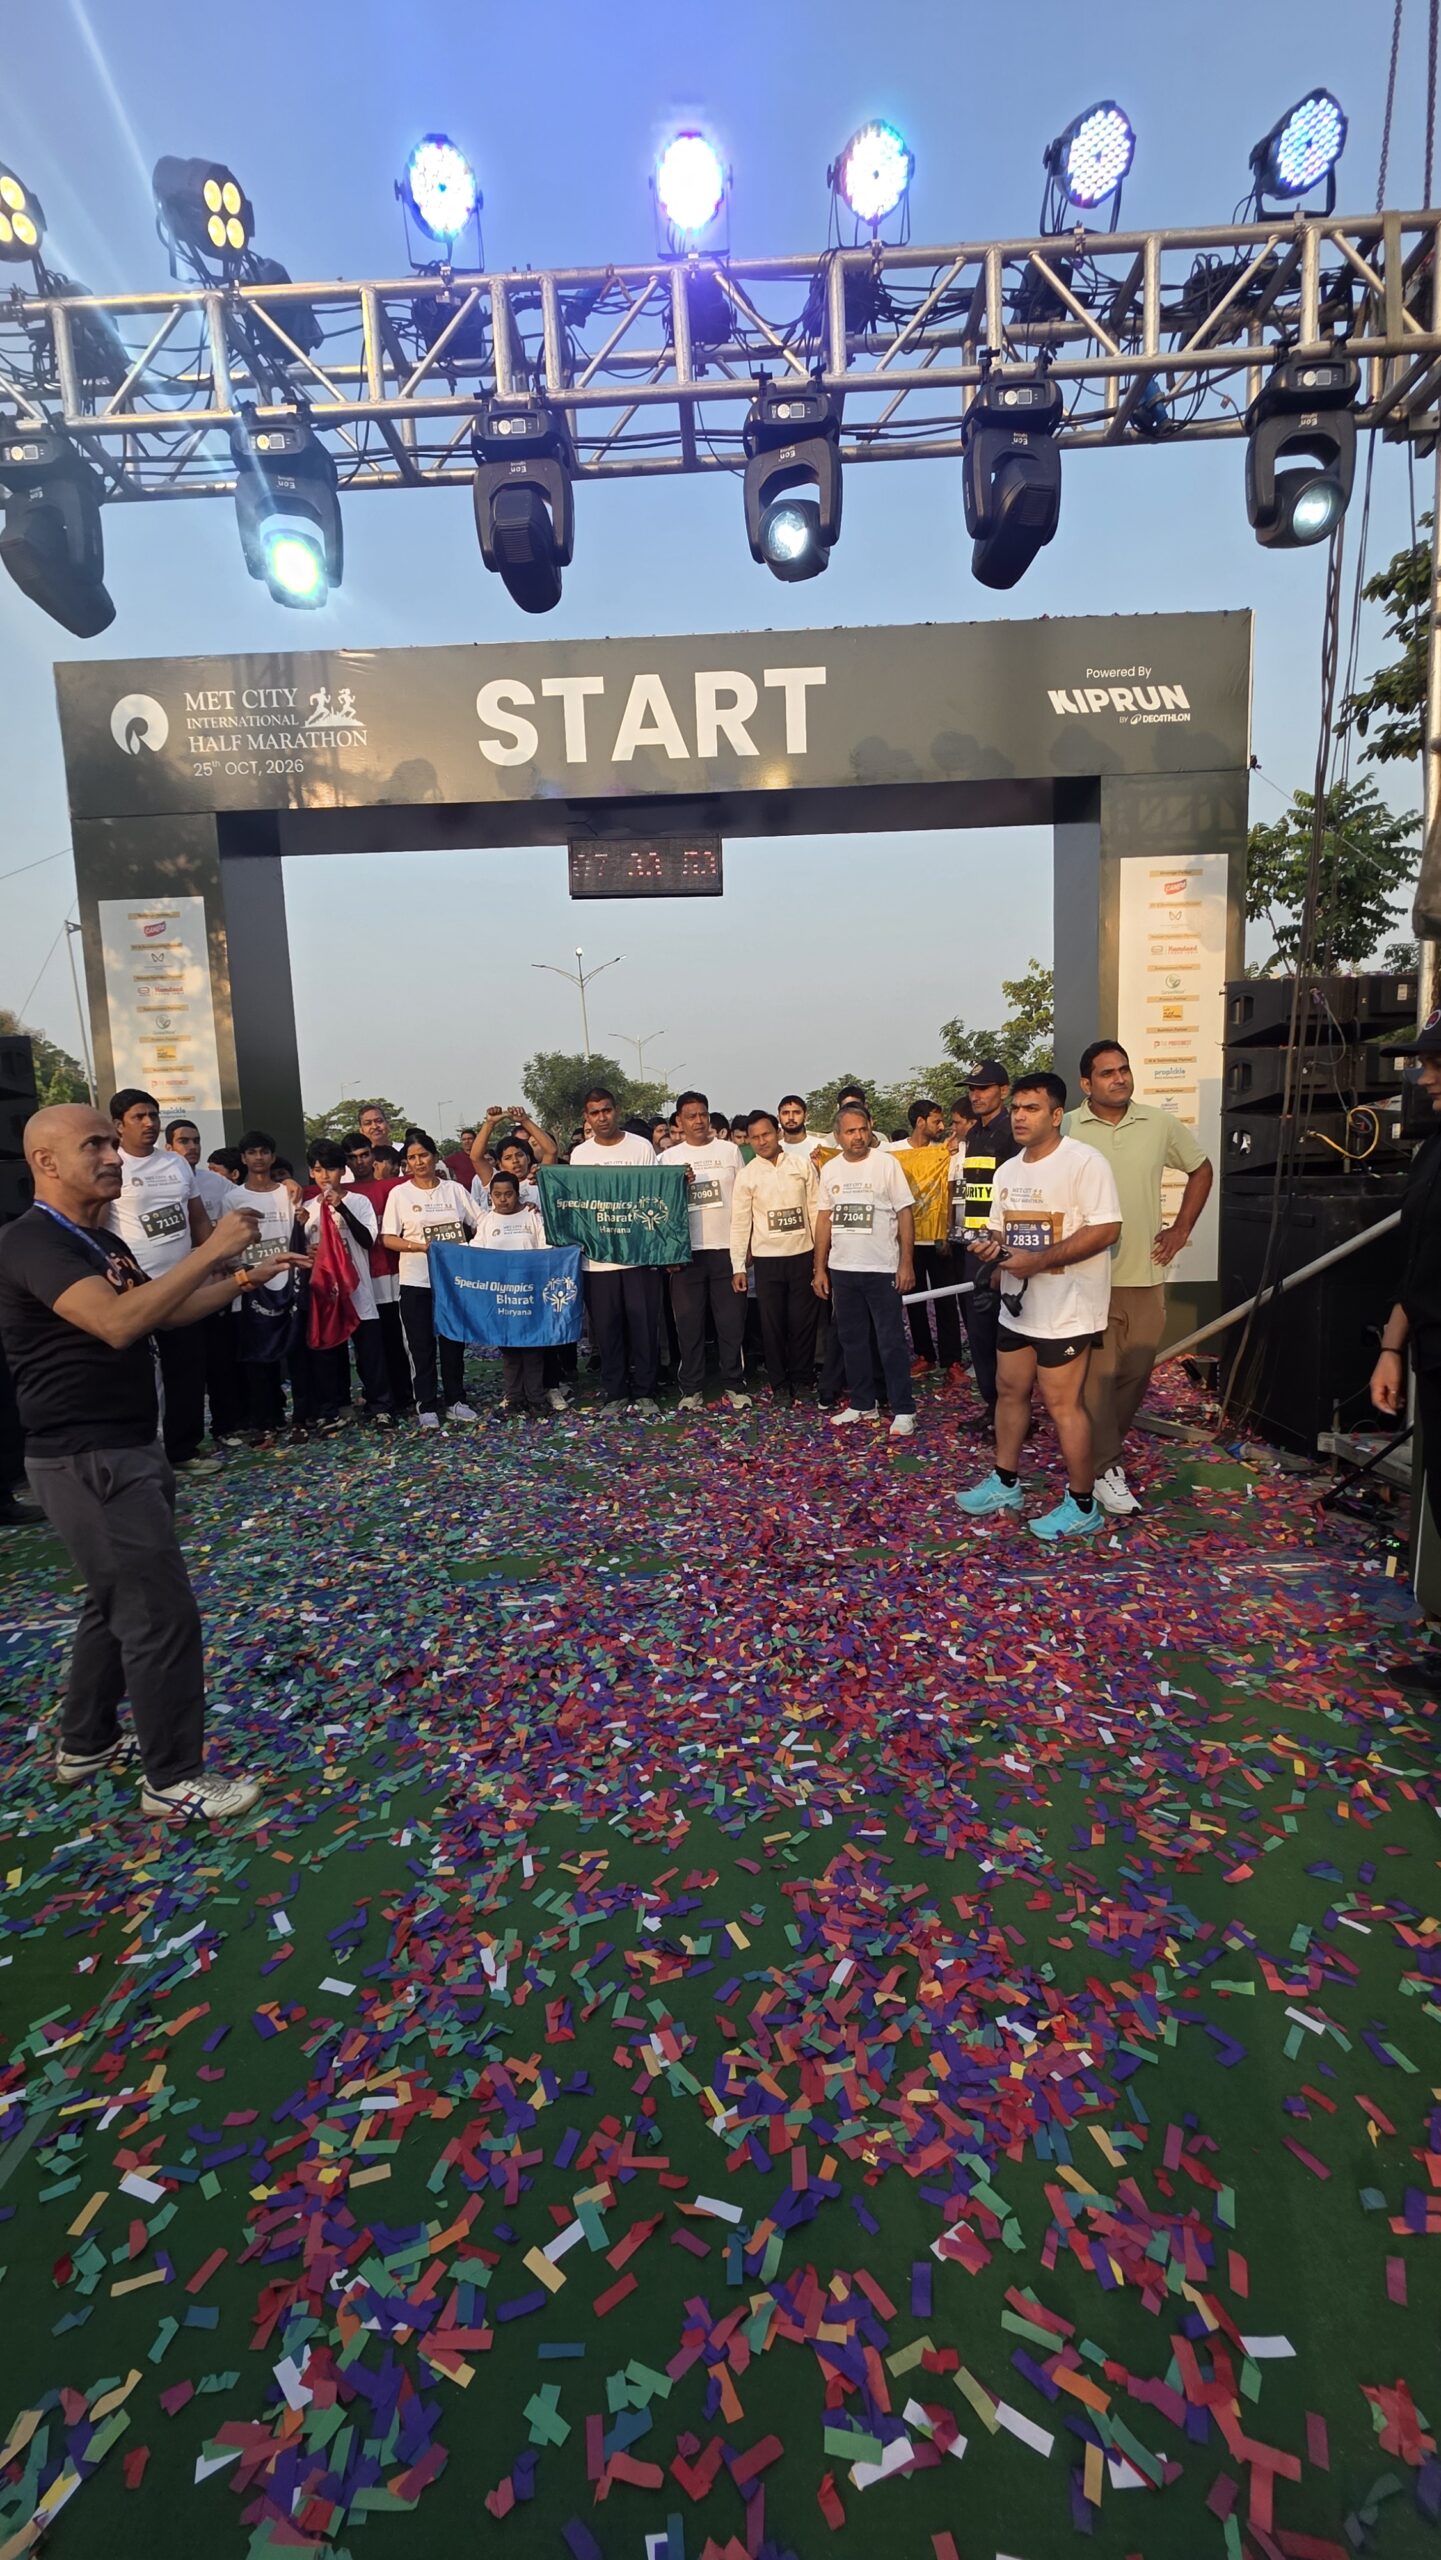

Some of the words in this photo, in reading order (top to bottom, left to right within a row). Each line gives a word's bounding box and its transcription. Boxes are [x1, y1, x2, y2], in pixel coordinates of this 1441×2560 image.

[1086, 666, 1136, 679] Powered
[1138, 666, 1152, 679] By
[184, 690, 236, 711] MET
[242, 688, 298, 709] CITY
[1048, 684, 1190, 714] KIPRUN
[186, 714, 299, 730] INTERNATIONAL
[476, 666, 826, 767] START
[1142, 714, 1191, 724] DECATHLON
[188, 734, 242, 752] HALF
[246, 730, 368, 751] MARATHON
[194, 760, 220, 777] 25th
[225, 760, 262, 776] OCT,
[265, 758, 304, 773] 2026
[692, 1190, 713, 1200] 7090
[556, 1199, 588, 1210] Special
[590, 1200, 633, 1211] Olympics
[156, 1214, 180, 1229] 7112
[596, 1212, 633, 1222] Bharat
[778, 1216, 797, 1226] 7195
[843, 1213, 864, 1221] 7104
[435, 1231, 456, 1241] 7190
[1013, 1235, 1039, 1246] 2833
[454, 1275, 488, 1291] Special
[490, 1282, 534, 1294] Olympics
[496, 1294, 534, 1305] Bharat
[497, 1308, 532, 1316] Haryana
